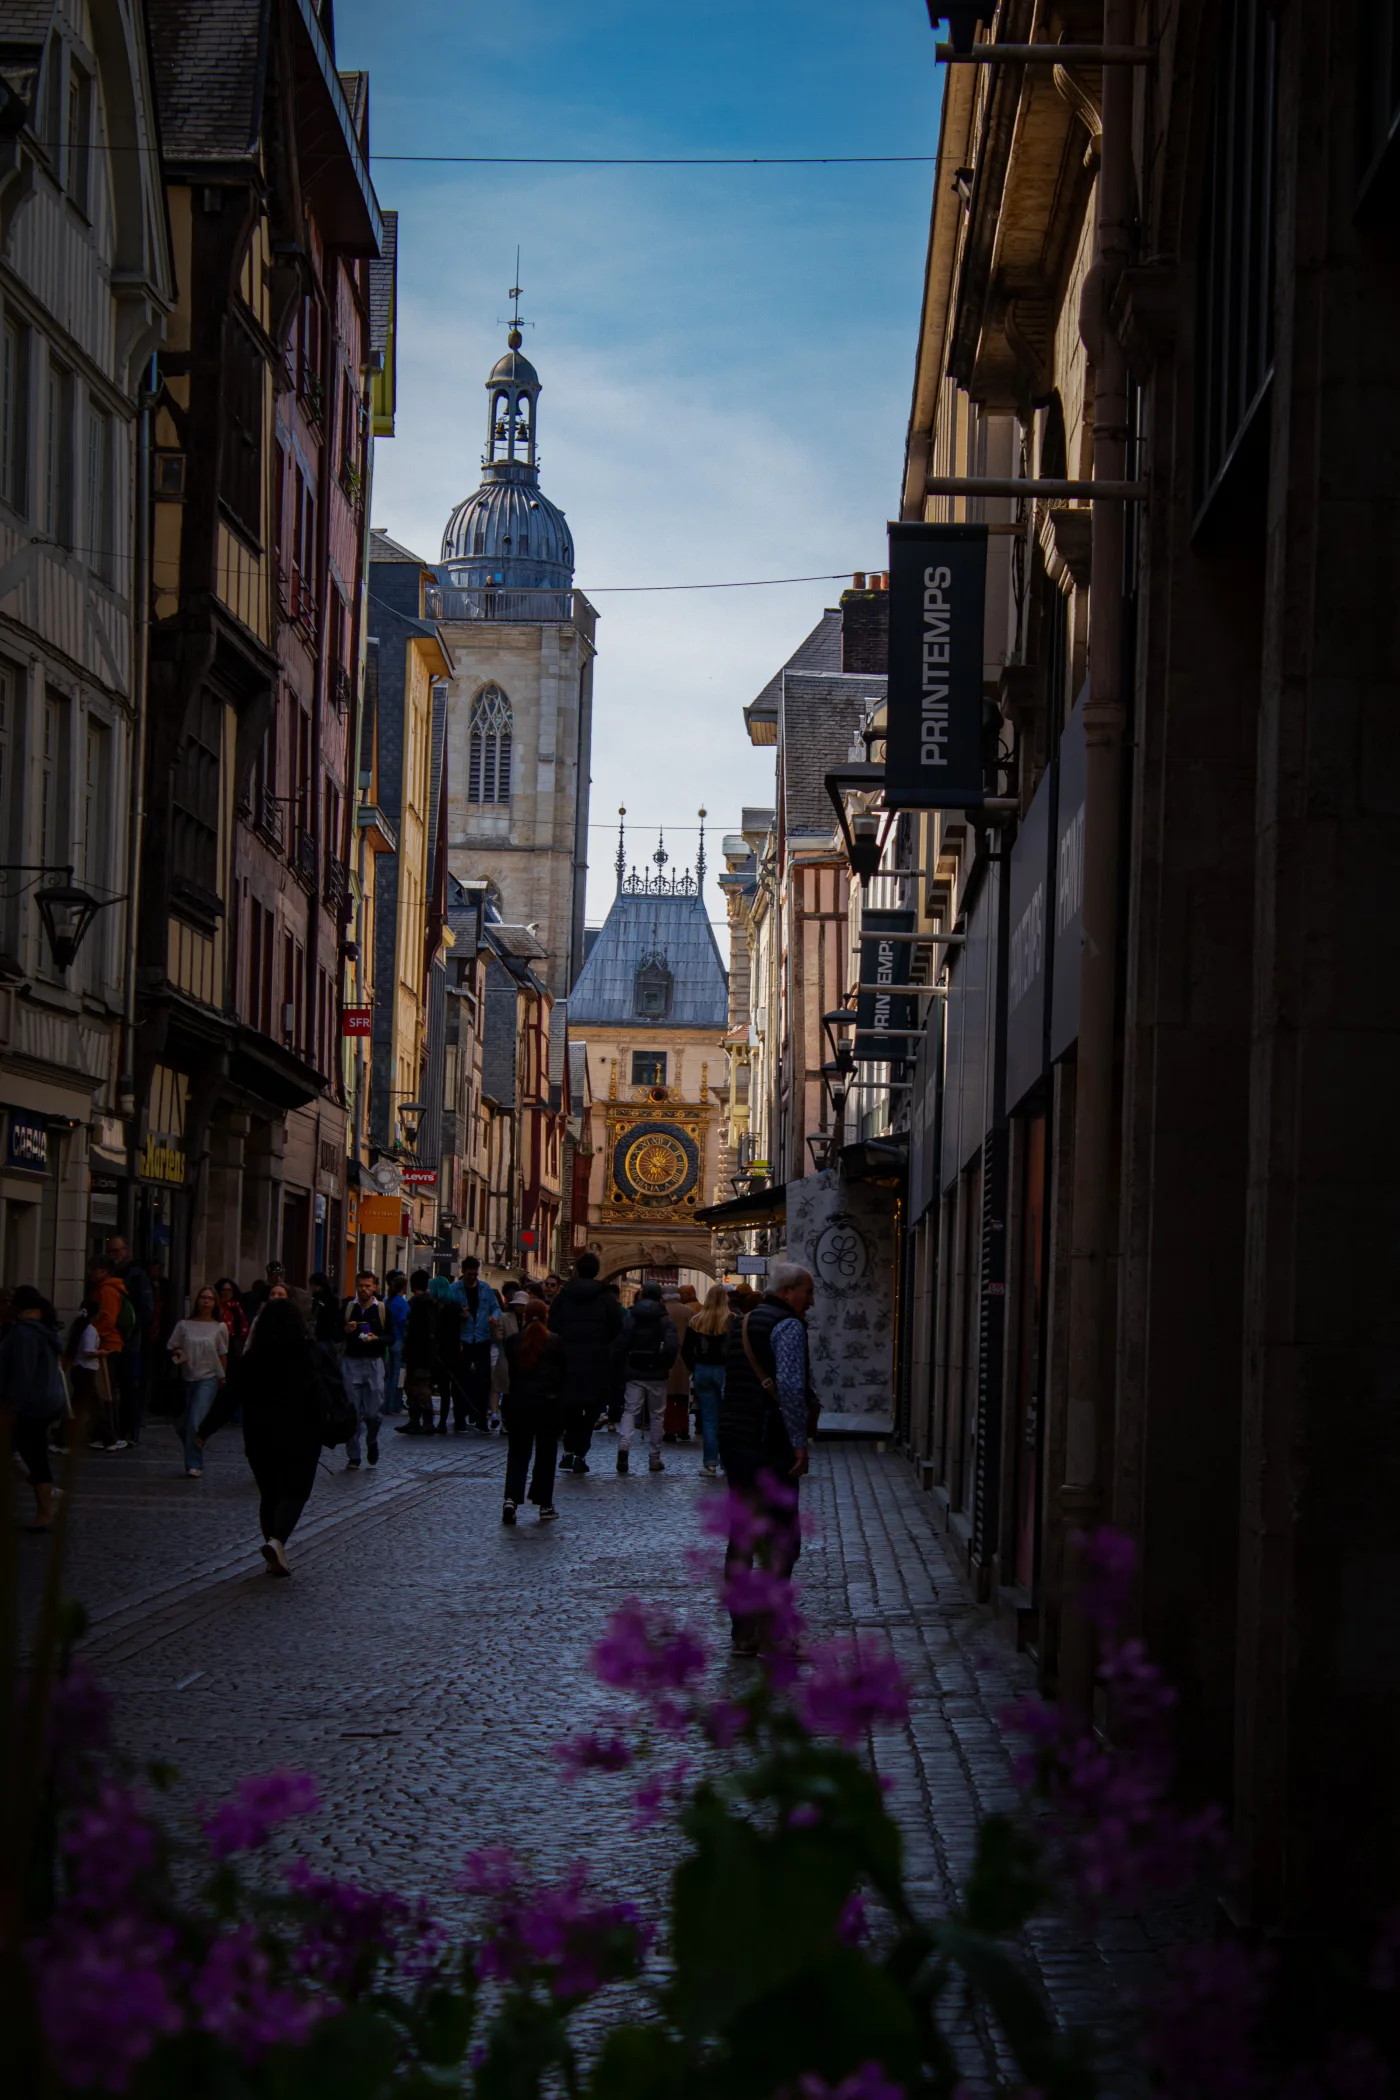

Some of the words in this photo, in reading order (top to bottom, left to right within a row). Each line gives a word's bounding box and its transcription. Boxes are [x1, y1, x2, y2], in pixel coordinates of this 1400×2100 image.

[921, 566, 951, 765] PRINTEMPS
[873, 940, 894, 1039] RINEMP
[349, 1017, 370, 1028] SFR
[640, 1140, 650, 1149] XI
[651, 1137, 664, 1145] XII
[632, 1147, 641, 1156] X
[146, 1134, 186, 1184] Martens
[664, 1182, 671, 1190] V
